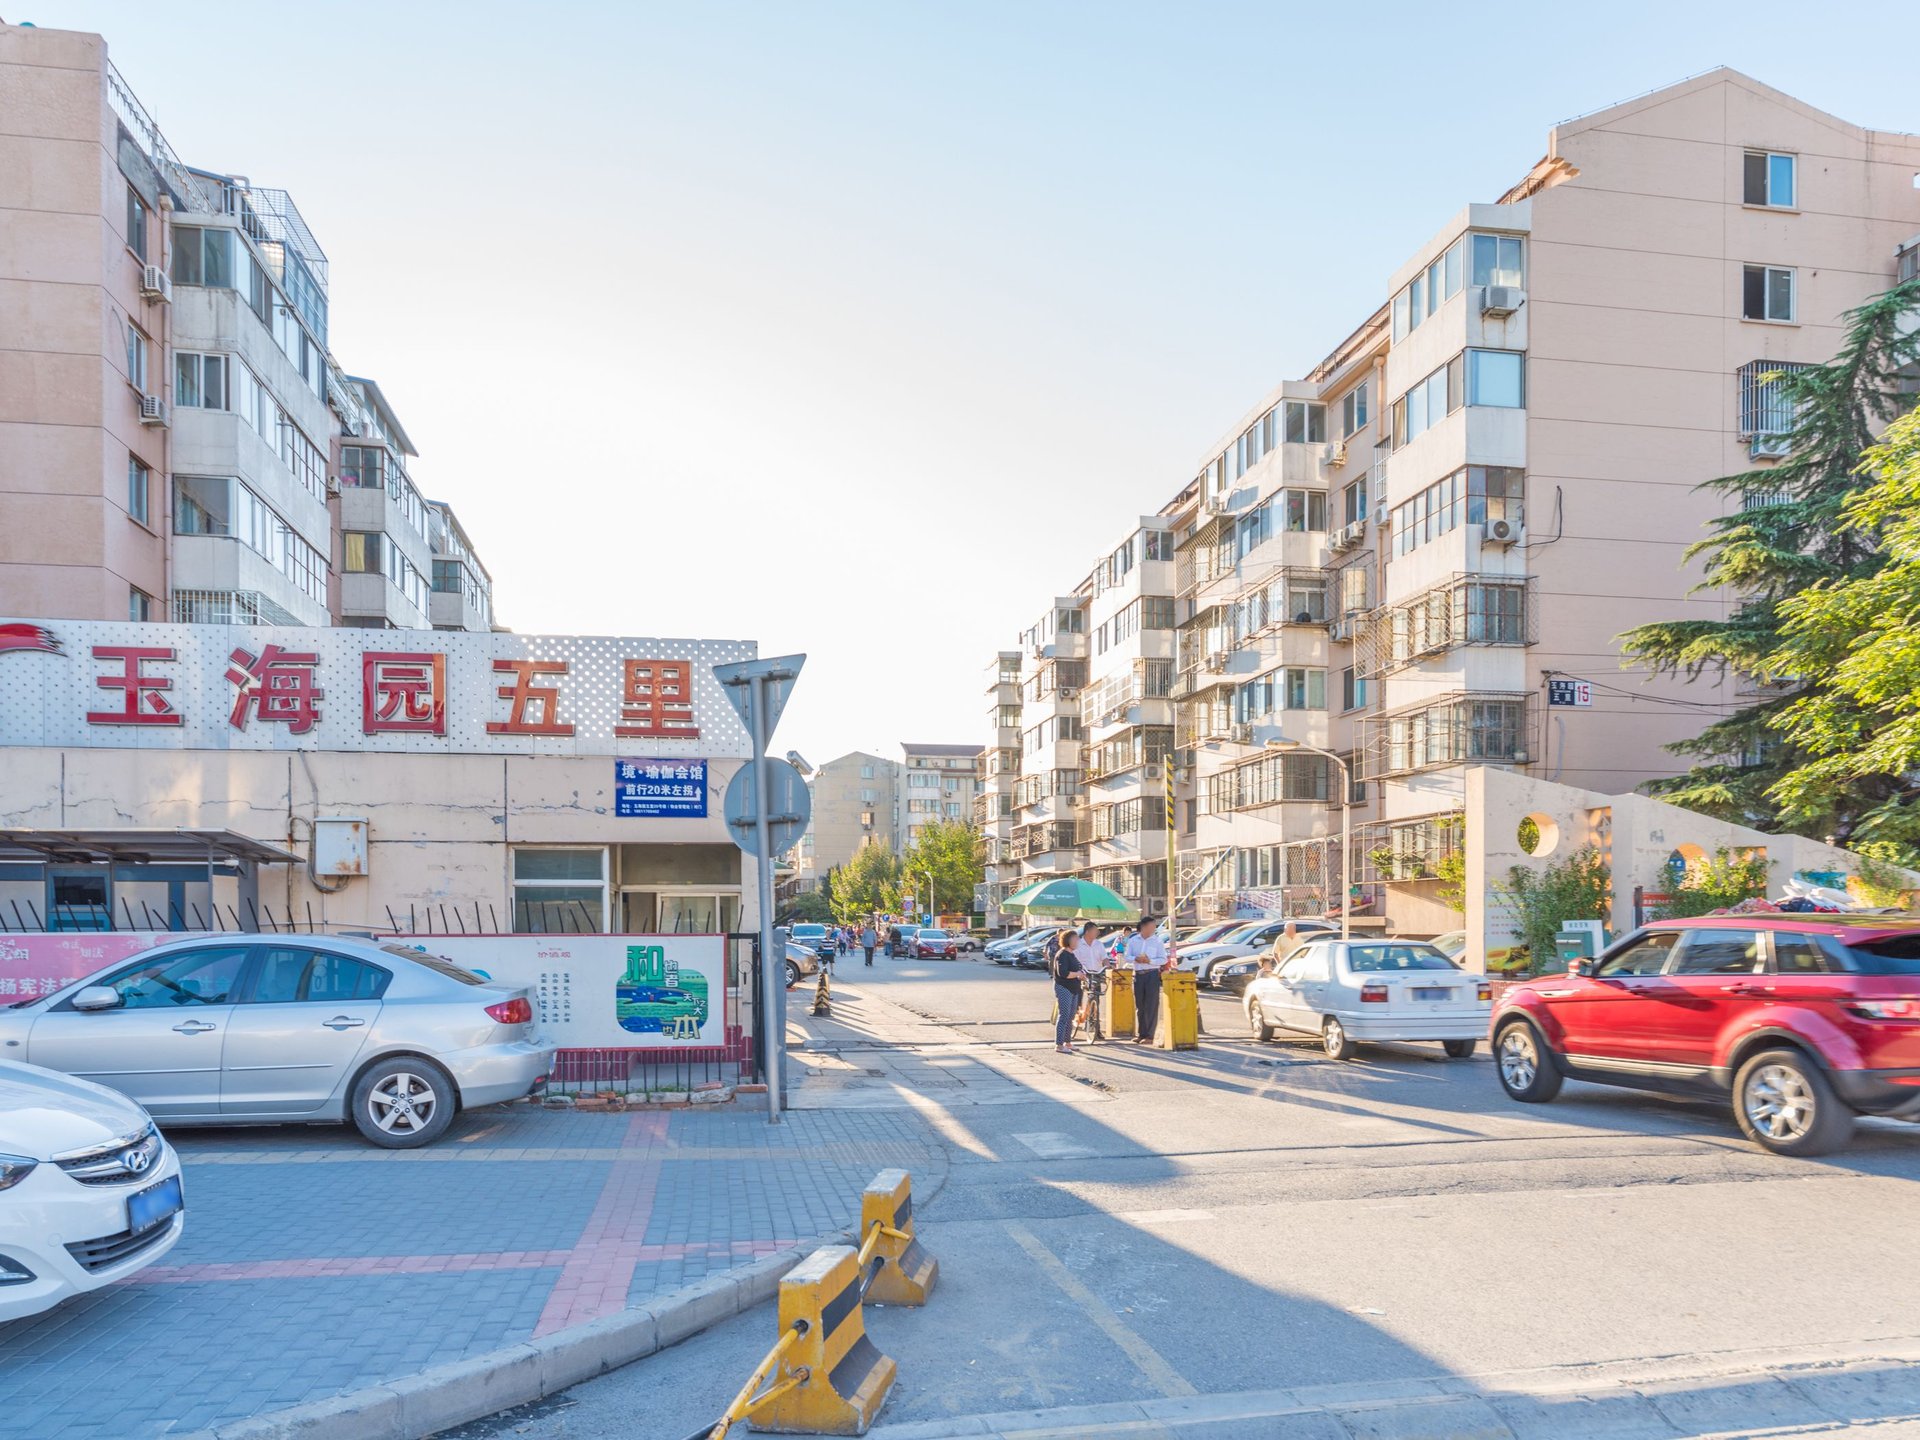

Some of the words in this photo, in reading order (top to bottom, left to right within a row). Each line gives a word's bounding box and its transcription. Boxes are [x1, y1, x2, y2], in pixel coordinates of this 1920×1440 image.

[86, 644, 700, 738] 玉海园五里
[1577, 685, 1589, 702] 15
[625, 784, 693, 796] 前行20米左拐
[627, 945, 664, 982] 和
